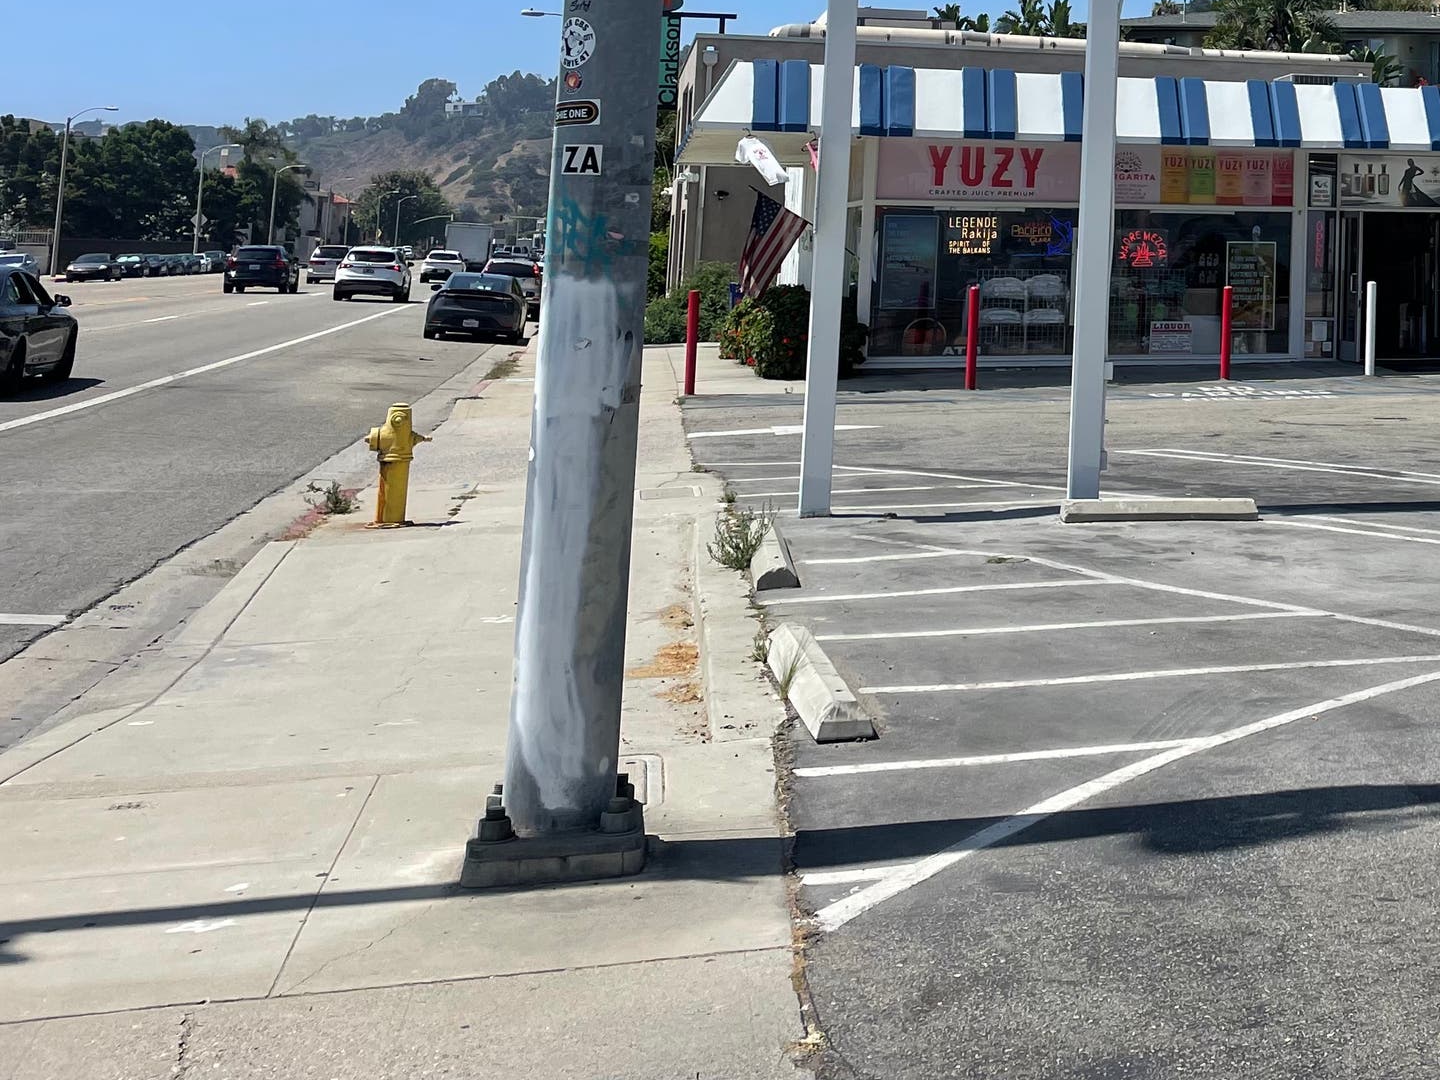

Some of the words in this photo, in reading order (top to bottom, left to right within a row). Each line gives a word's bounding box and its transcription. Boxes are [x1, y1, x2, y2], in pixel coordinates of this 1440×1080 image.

[658, 15, 682, 106] Clarkson
[568, 108, 588, 119] ONE
[563, 146, 600, 174] ZA
[928, 145, 1045, 188] YUZY
[949, 217, 998, 228] LEGENDE
[961, 228, 998, 241] Rakija
[1010, 224, 1052, 237] PACIFICO
[1119, 230, 1142, 260] MADRE
[1143, 230, 1168, 260] MEZCAL
[1314, 220, 1323, 268] OPEN
[962, 247, 991, 255] BALKANS
[1153, 322, 1191, 330] LIQUOR
